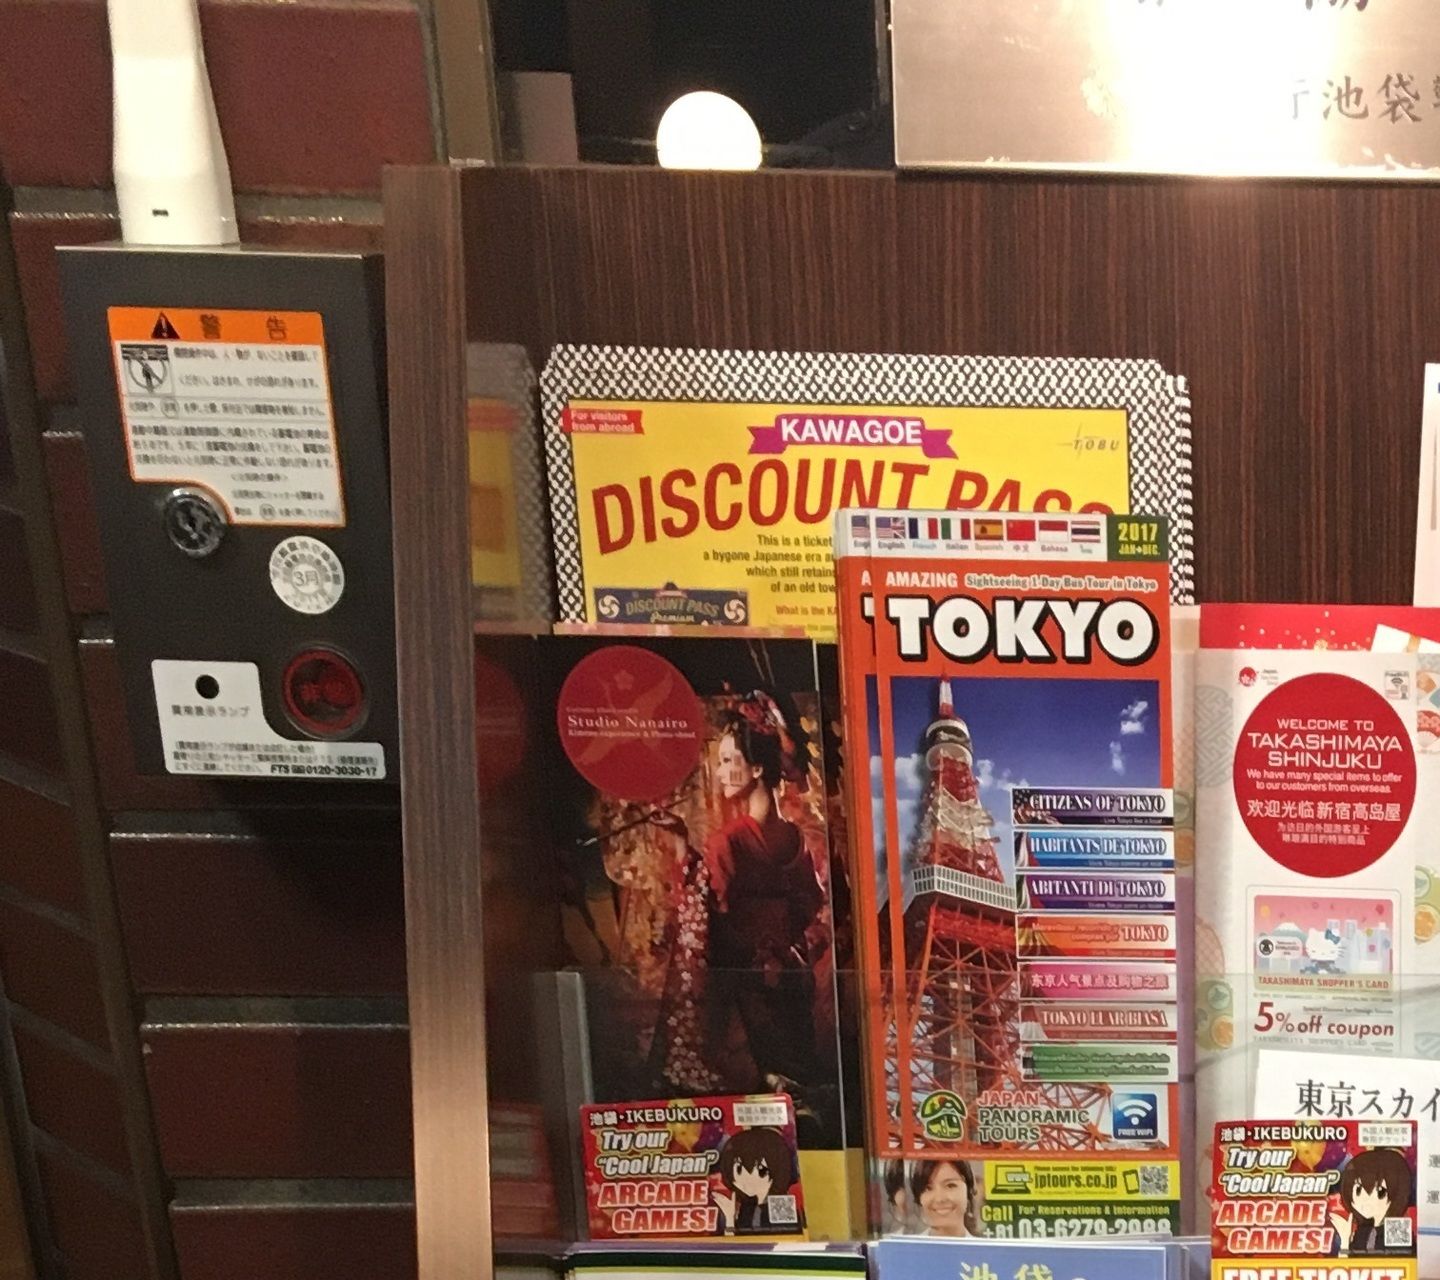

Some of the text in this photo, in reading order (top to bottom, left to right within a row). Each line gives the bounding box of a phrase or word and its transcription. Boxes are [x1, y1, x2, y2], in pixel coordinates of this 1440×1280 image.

[780, 420, 922, 444] KAWAGOE
[592, 458, 929, 554] DISCOUNT
[758, 535, 779, 546] This
[1118, 522, 1158, 541] 2017
[753, 551, 802, 563] Japanese
[746, 566, 777, 576] which
[886, 571, 1028, 589] AMAZING Sightseeing
[886, 594, 1160, 665] TOKYO
[567, 714, 620, 728] Studio
[1277, 718, 1374, 731] WELCOME TO
[1247, 732, 1403, 751] TAKASHIMAYA
[1268, 751, 1382, 769] SHINJUKU
[1287, 771, 1311, 781] many
[1281, 781, 1327, 792] customers
[1030, 794, 1165, 813] CITIZENS OF TOKYO
[1030, 836, 1167, 855] HABITANTS DE TOKYO
[1032, 880, 1166, 897] ABITANTI TOKYO
[1122, 925, 1169, 941] TOKYO
[1258, 975, 1314, 988] TAKASHIMAYA
[1042, 1010, 1168, 1027] TOKYO BIASA
[1254, 1001, 1295, 1032] 5%
[1298, 1015, 1322, 1034] off
[1327, 1020, 1394, 1039] coupon
[976, 1090, 1041, 1106] JAPAN
[977, 1108, 1091, 1125] PANORAMIC
[602, 1131, 668, 1151] Try our
[977, 1126, 1041, 1142] TOURS
[1228, 1149, 1291, 1169] Try our
[599, 1182, 708, 1206] ARCADE
[613, 1208, 718, 1232] GAMES!
[981, 1205, 1014, 1222] Call
[1217, 1201, 1327, 1226] ARCADE
[1228, 1227, 1334, 1253] GAMES!
